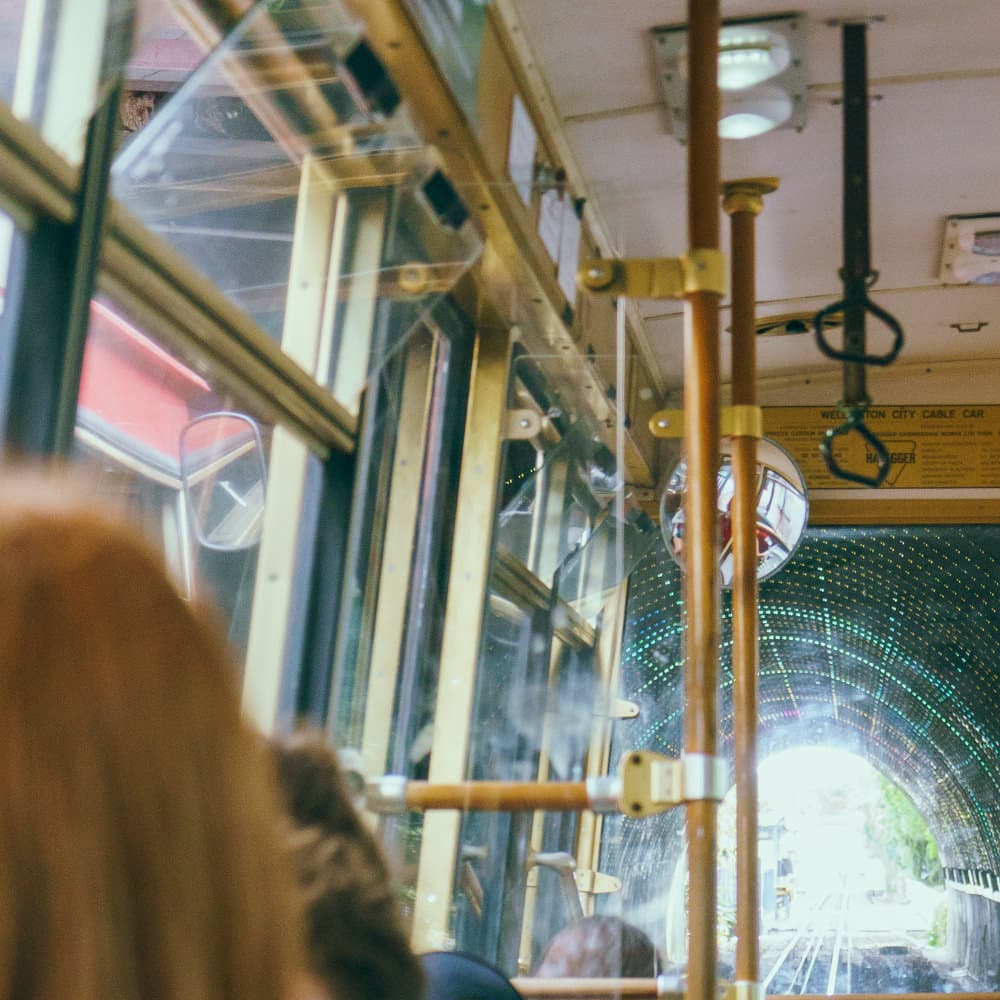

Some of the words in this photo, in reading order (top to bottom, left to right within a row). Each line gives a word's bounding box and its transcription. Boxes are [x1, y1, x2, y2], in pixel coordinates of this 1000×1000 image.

[821, 410, 886, 419] WELLTON
[892, 410, 915, 418] CITY
[922, 410, 955, 418] CABLE
[963, 409, 984, 418] CAR
[866, 453, 916, 464] HAGGER
